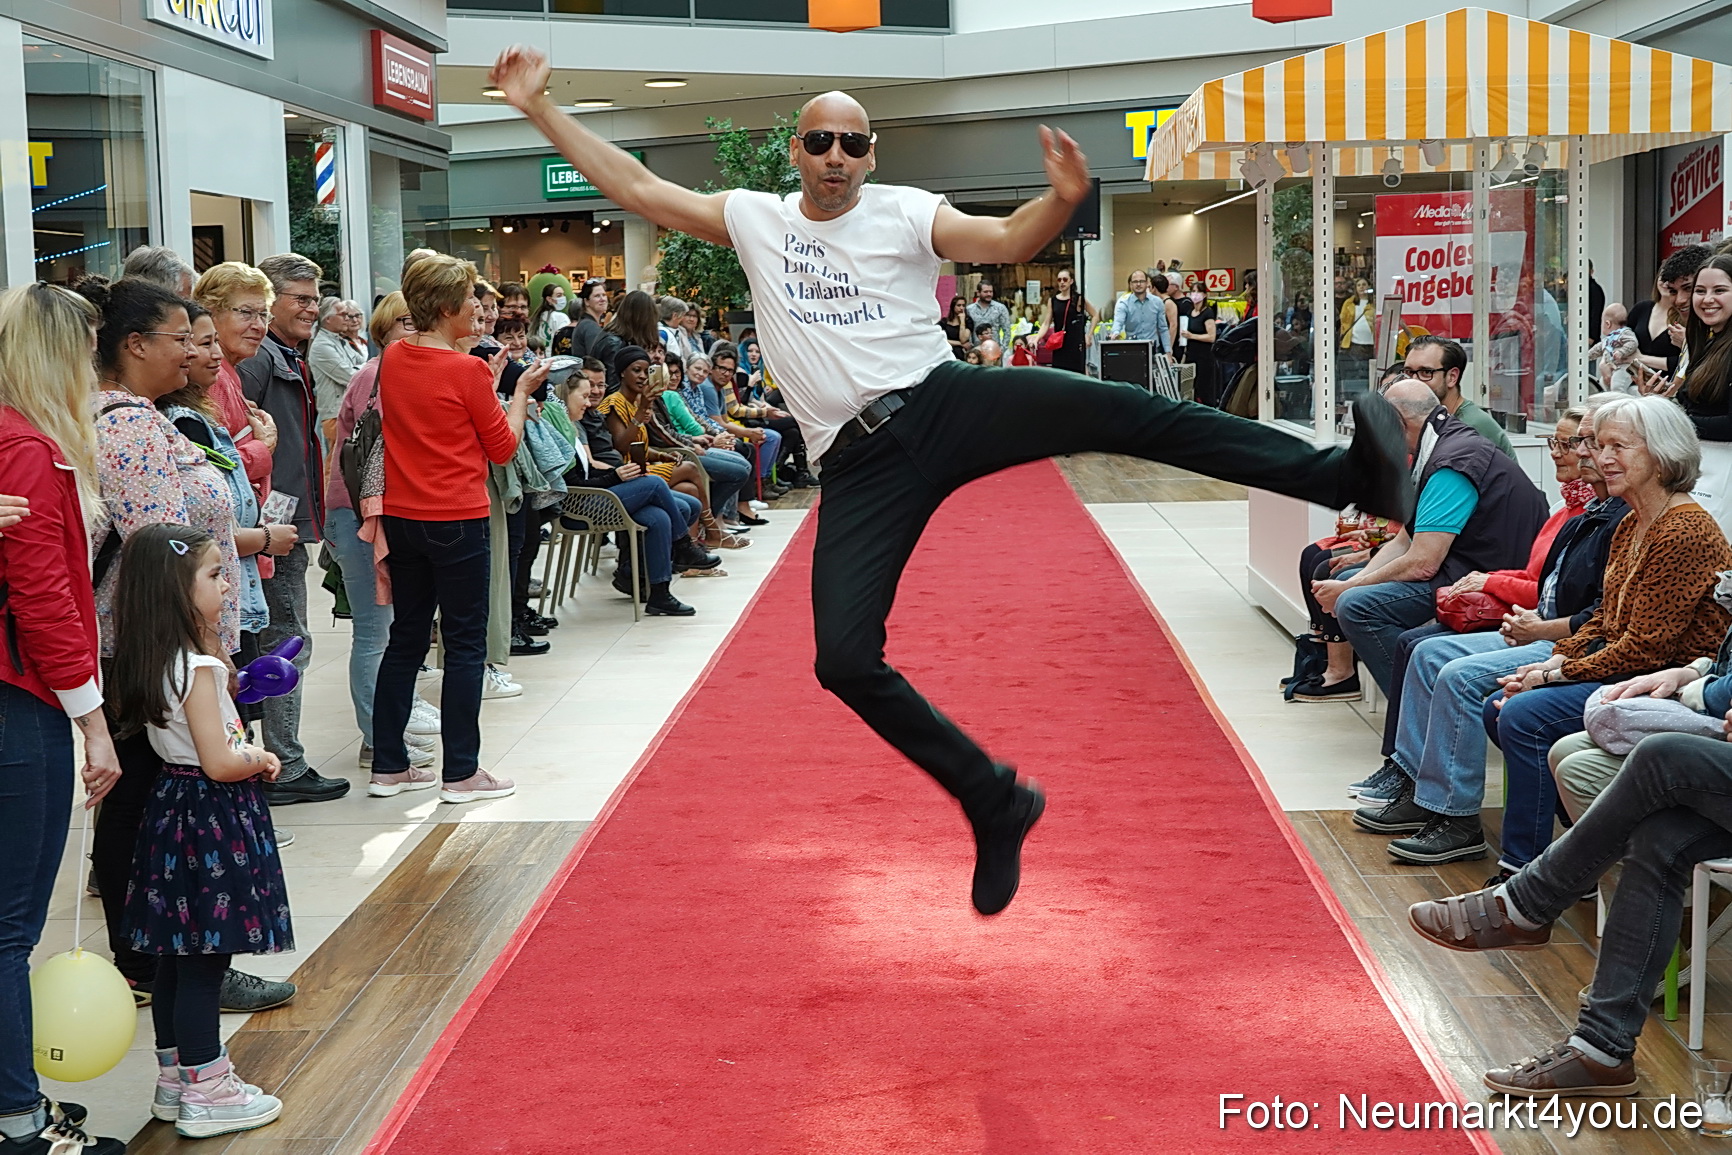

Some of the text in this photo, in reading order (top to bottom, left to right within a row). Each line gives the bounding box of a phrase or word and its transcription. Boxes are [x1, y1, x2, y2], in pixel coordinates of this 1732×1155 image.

[386, 58, 429, 96] LEBENSRAUM
[1669, 144, 1720, 218] Service
[784, 233, 826, 258] Paris
[785, 281, 859, 300] Mailand
[1208, 273, 1227, 288] 2€
[788, 302, 887, 326] Neumarkt
